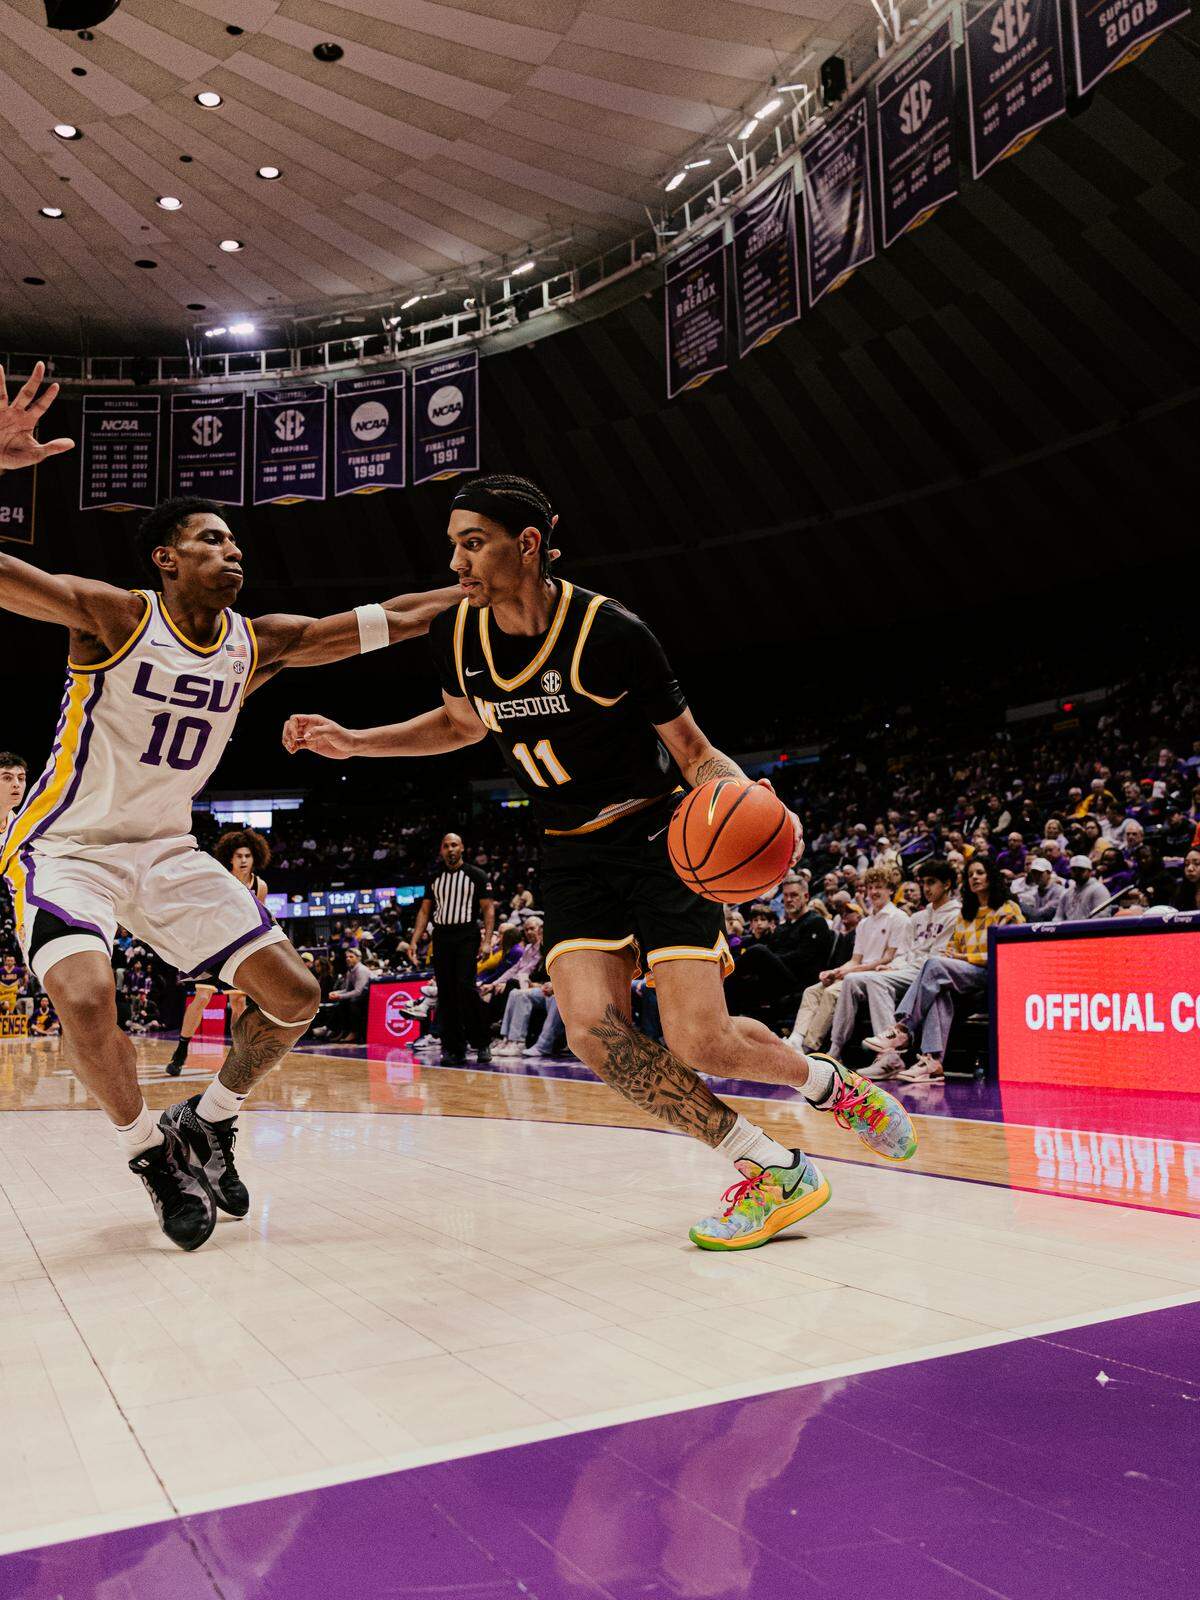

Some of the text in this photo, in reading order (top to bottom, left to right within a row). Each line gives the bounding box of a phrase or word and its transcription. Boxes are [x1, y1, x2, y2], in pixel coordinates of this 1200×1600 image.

[1099, 0, 1133, 28] SUPE
[898, 79, 932, 135] SEC
[676, 282, 717, 318] BREAUX
[432, 402, 462, 418] NCAA
[100, 420, 139, 431] NCAA
[191, 415, 223, 447] SEC
[274, 409, 306, 441] SEC
[354, 419, 388, 432] NCAA
[271, 444, 309, 455] CHAMPIONS
[425, 435, 466, 453] FINAL FOUR
[348, 452, 391, 466] FINAL FOUR
[432, 449, 459, 465] 1991
[353, 463, 385, 479] 1990
[0, 506, 24, 523] 24
[132, 662, 241, 713] LSU
[543, 671, 561, 692] SEC
[140, 712, 212, 771] 10
[512, 739, 572, 788] 11
[329, 893, 356, 904] 12:57
[1025, 992, 1200, 1033] OFFICIAL C
[0, 1017, 27, 1035] ENSE
